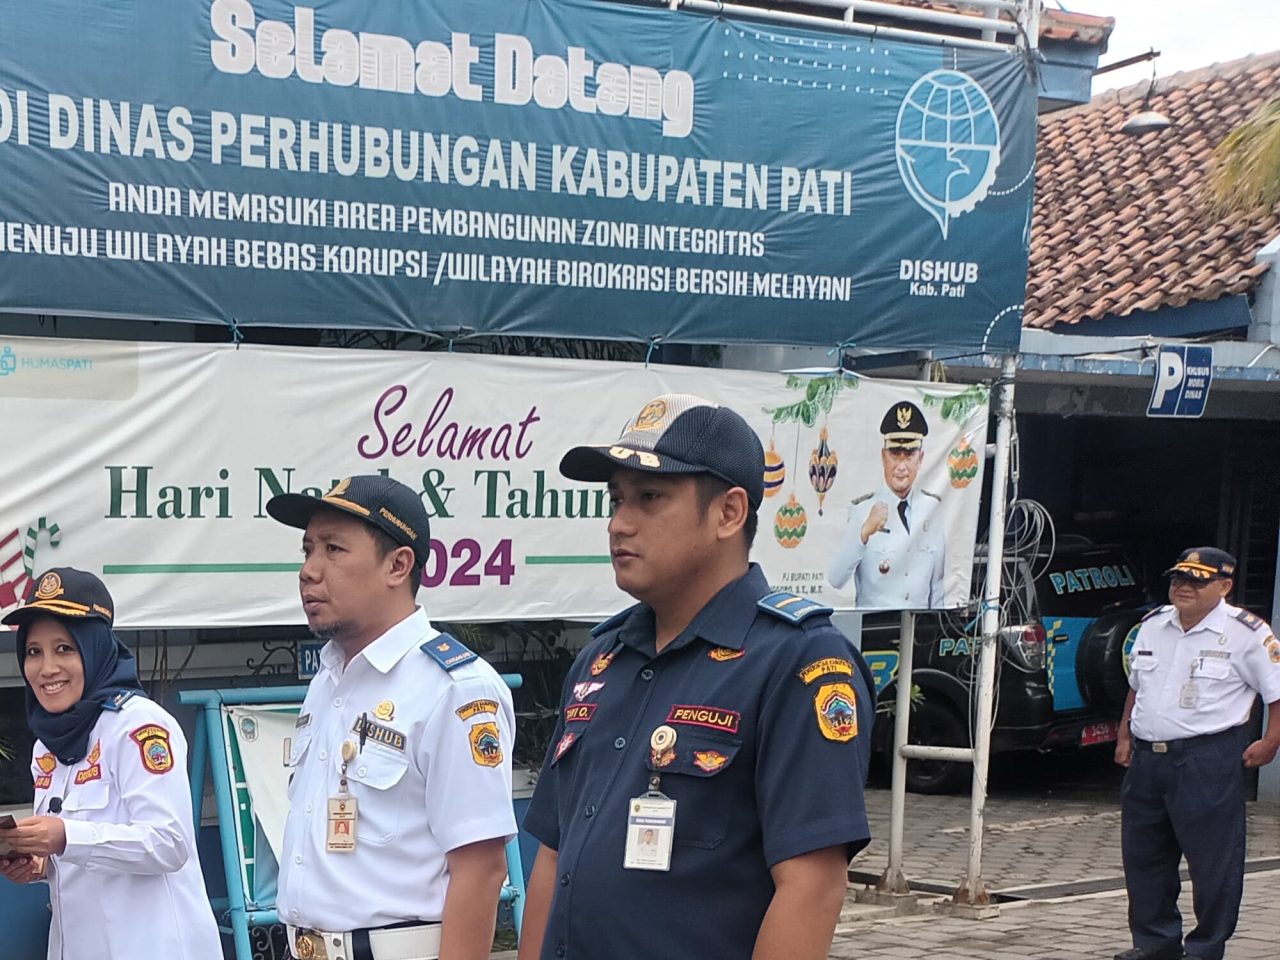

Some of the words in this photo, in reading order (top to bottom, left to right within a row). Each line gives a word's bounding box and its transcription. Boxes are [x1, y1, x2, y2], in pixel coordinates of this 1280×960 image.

[210, 0, 482, 101] Selamat
[494, 33, 695, 138] Datang
[48, 93, 195, 162] DINAS
[210, 107, 537, 191] PERHUBUNGAN
[551, 144, 770, 210] KABUPATEN
[780, 167, 852, 216] PATI
[109, 182, 182, 217] ANDA
[189, 189, 327, 227] MEMASUKI
[333, 201, 396, 232] AREA
[402, 206, 577, 244] PEMBANGUNAN
[581, 219, 639, 249] ZONA
[643, 224, 765, 257] INTEGRITAS
[105, 229, 227, 266] WILAYAH
[234, 239, 316, 271] BEBAS
[323, 244, 428, 278] KORUPSI
[433, 252, 551, 286] /WILAYAH
[556, 260, 671, 292] BIROKRASI
[675, 267, 748, 296] BERSIH
[752, 273, 852, 301] MELAYANI
[899, 260, 979, 283] DISHUB
[909, 282, 946, 297] Kab.
[950, 284, 966, 298] Pati
[1151, 352, 1183, 408] P
[357, 384, 541, 462] Selamat
[103, 465, 230, 519] Hari
[423, 538, 515, 588] 024
[1049, 565, 1136, 595] PATROLI
[674, 709, 734, 727] PENGUJI
